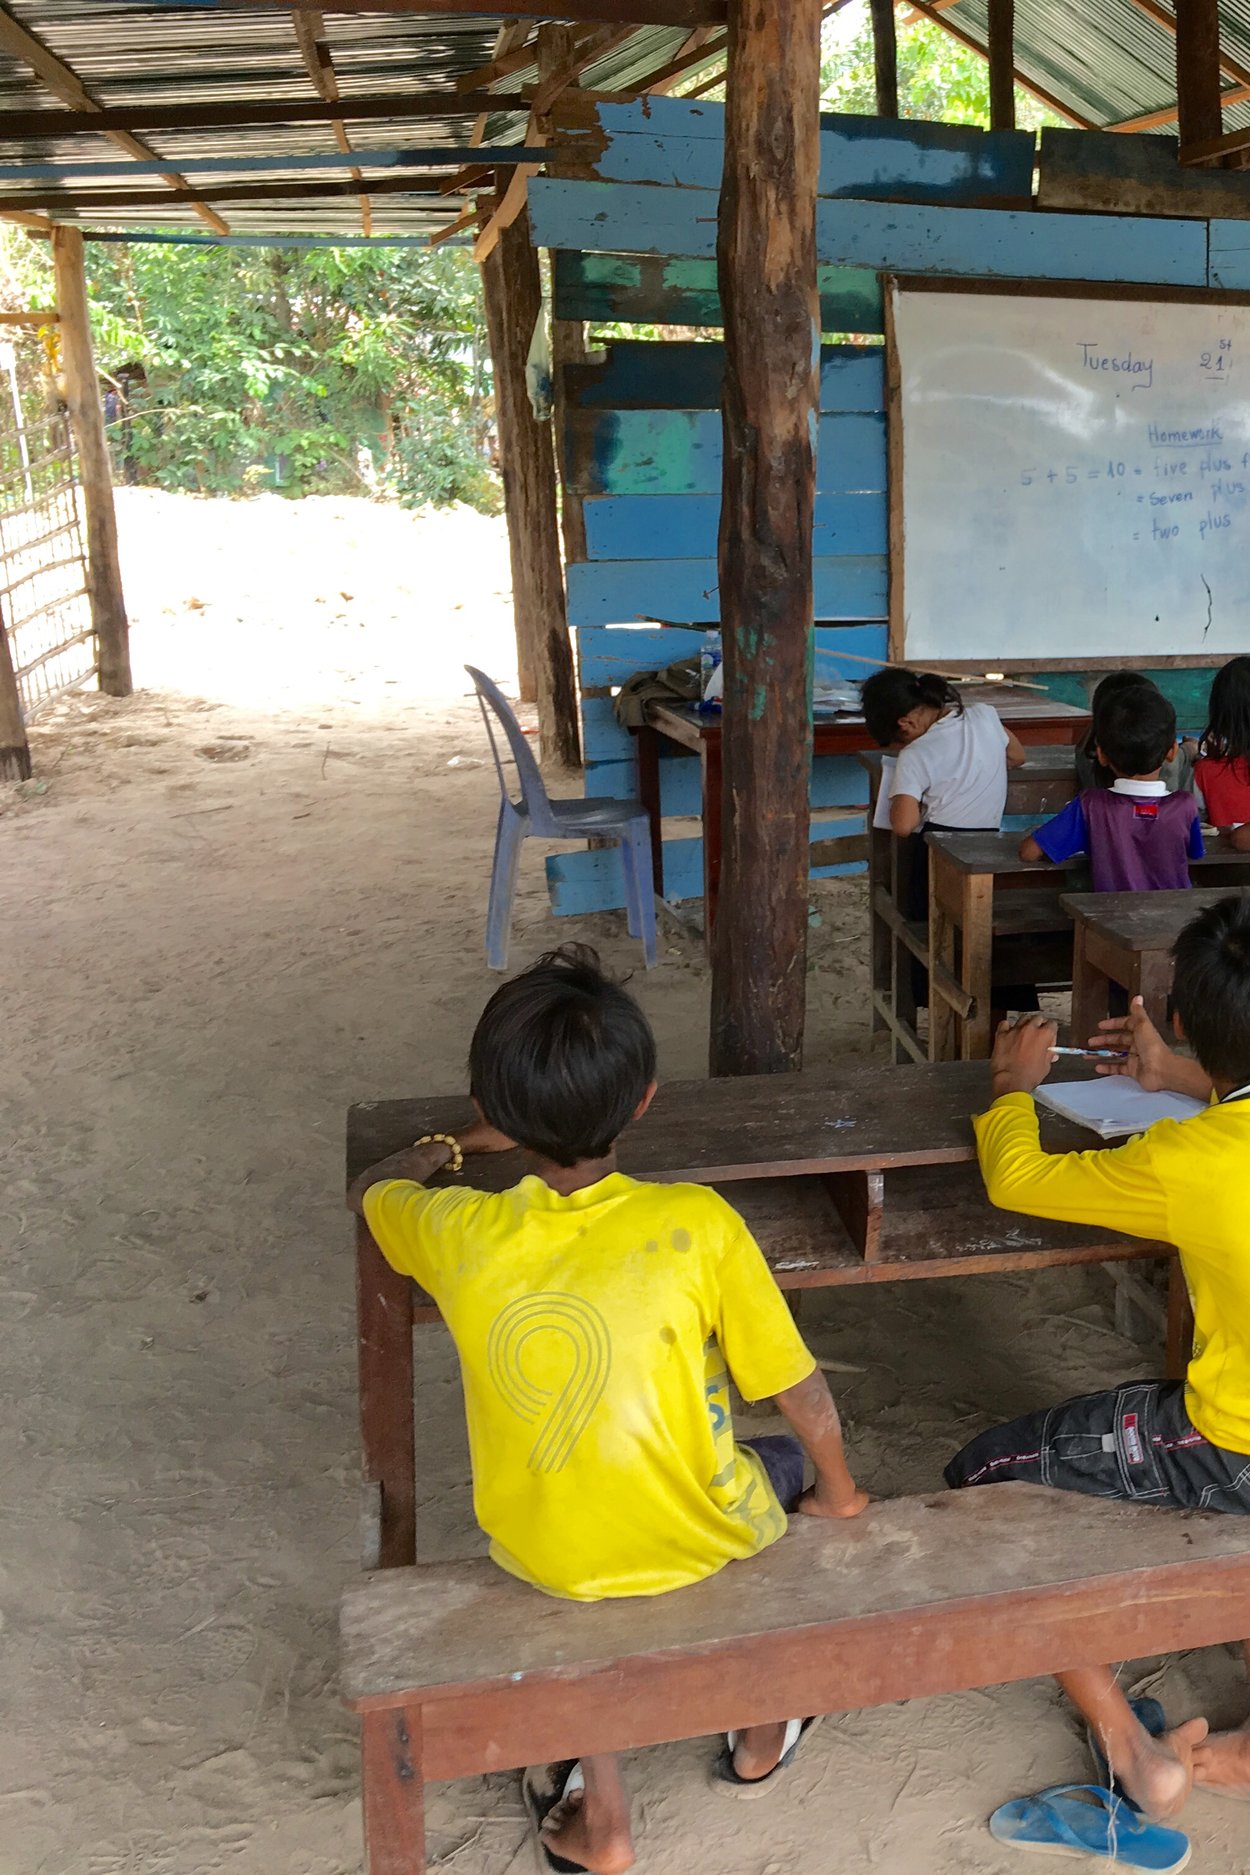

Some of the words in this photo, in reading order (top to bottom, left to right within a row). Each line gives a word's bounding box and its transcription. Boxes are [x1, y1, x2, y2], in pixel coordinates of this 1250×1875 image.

[1076, 342, 1153, 391] Tuesday
[1020, 467, 1037, 486] 5
[1065, 466, 1078, 484] 5
[1106, 460, 1126, 479] 10
[1153, 455, 1188, 478] five
[1200, 453, 1231, 480] plus
[1211, 478, 1245, 503] plus
[1151, 518, 1180, 541] two
[1199, 510, 1231, 541] plus
[488, 1291, 612, 1473] 9
